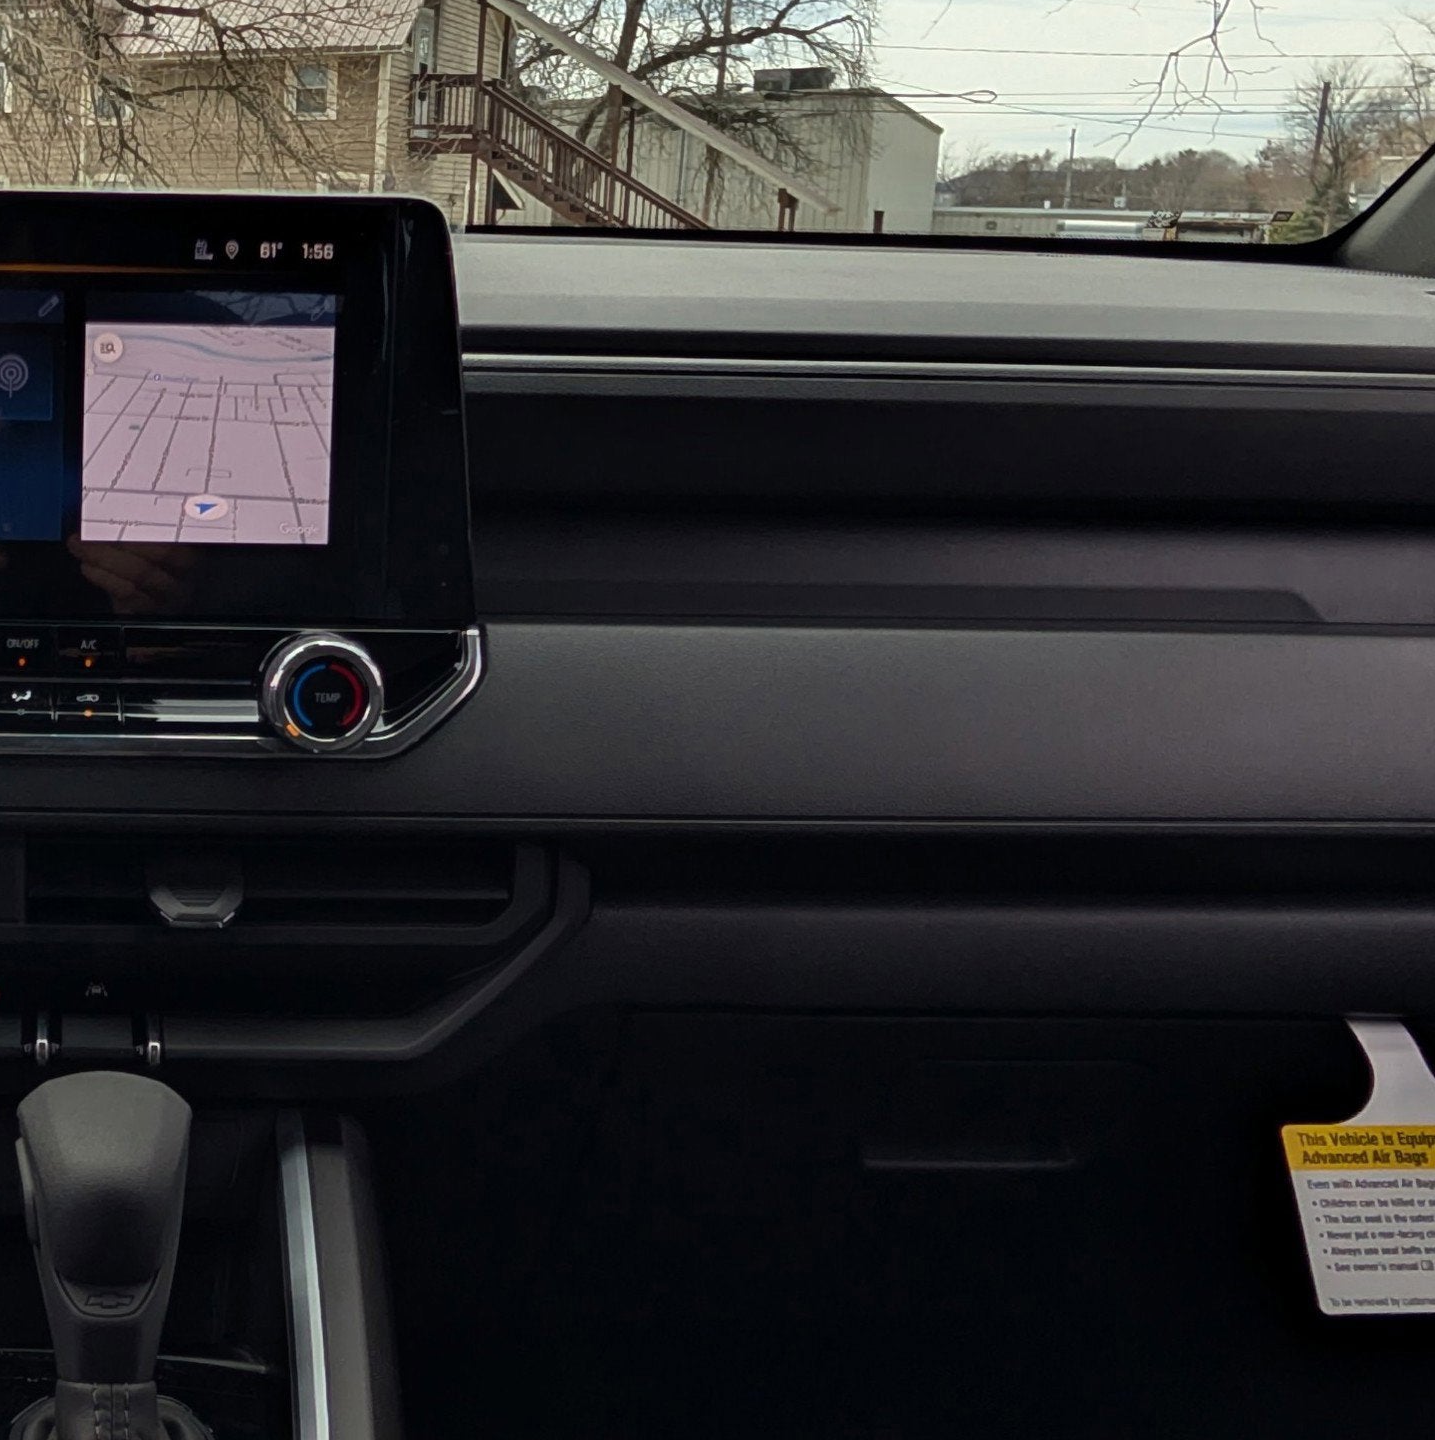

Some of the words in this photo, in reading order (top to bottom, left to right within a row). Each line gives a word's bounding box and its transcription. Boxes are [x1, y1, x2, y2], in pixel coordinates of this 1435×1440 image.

[6, 639, 40, 650] ON/OFF
[81, 639, 97, 650] A/C
[314, 692, 341, 703] TEMP
[1297, 1132, 1327, 1146] This
[1331, 1132, 1378, 1146] Vehicle
[1382, 1132, 1394, 1145] is
[1302, 1150, 1368, 1164] Advanced
[1372, 1150, 1391, 1163] Air
[1394, 1150, 1429, 1166] Bags
